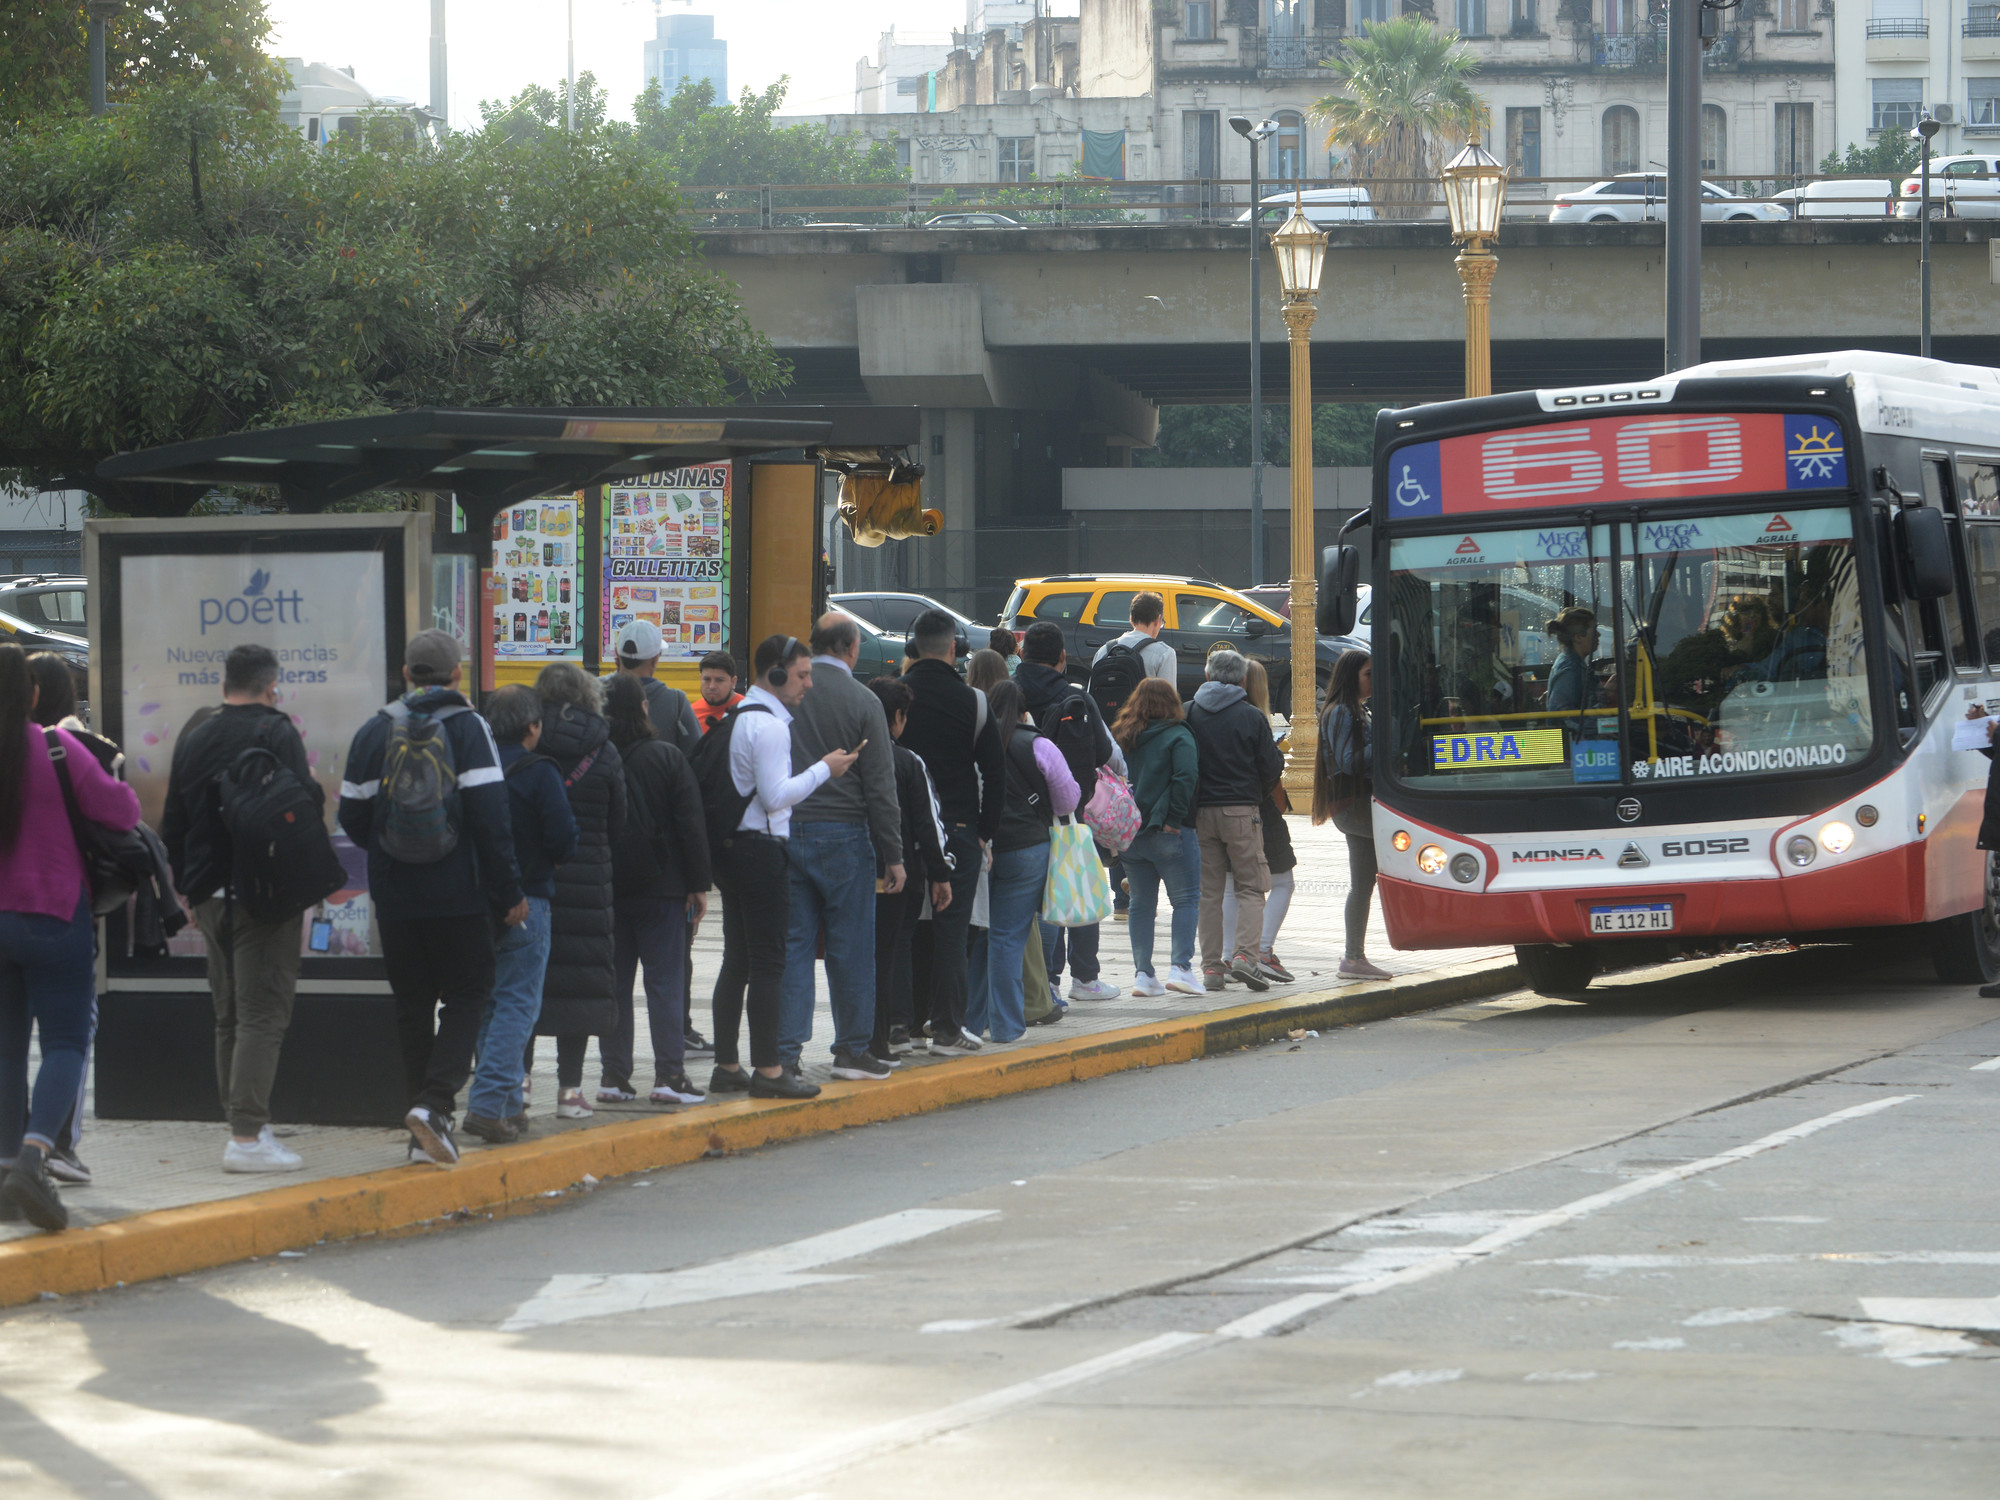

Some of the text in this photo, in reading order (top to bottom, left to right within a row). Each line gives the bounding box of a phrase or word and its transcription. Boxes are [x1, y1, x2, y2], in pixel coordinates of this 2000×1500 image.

[1482, 416, 1743, 500] 60
[1536, 531, 1588, 548] MEGA
[1644, 523, 1703, 541] MEGA
[1756, 533, 1798, 544] AGRALE
[1546, 543, 1583, 558] CAR
[1654, 535, 1693, 551] CAR
[612, 559, 722, 577] GALLETITAS
[1446, 555, 1486, 565] AGRALE
[200, 589, 304, 636] poett
[178, 667, 221, 685] más
[1575, 751, 1617, 768] SUBE
[1654, 743, 1846, 778] AIRE ACONDICIONADO
[1512, 848, 1605, 863] MONSA
[1662, 837, 1750, 857] 6052
[1595, 912, 1668, 930] AE 112 HI
